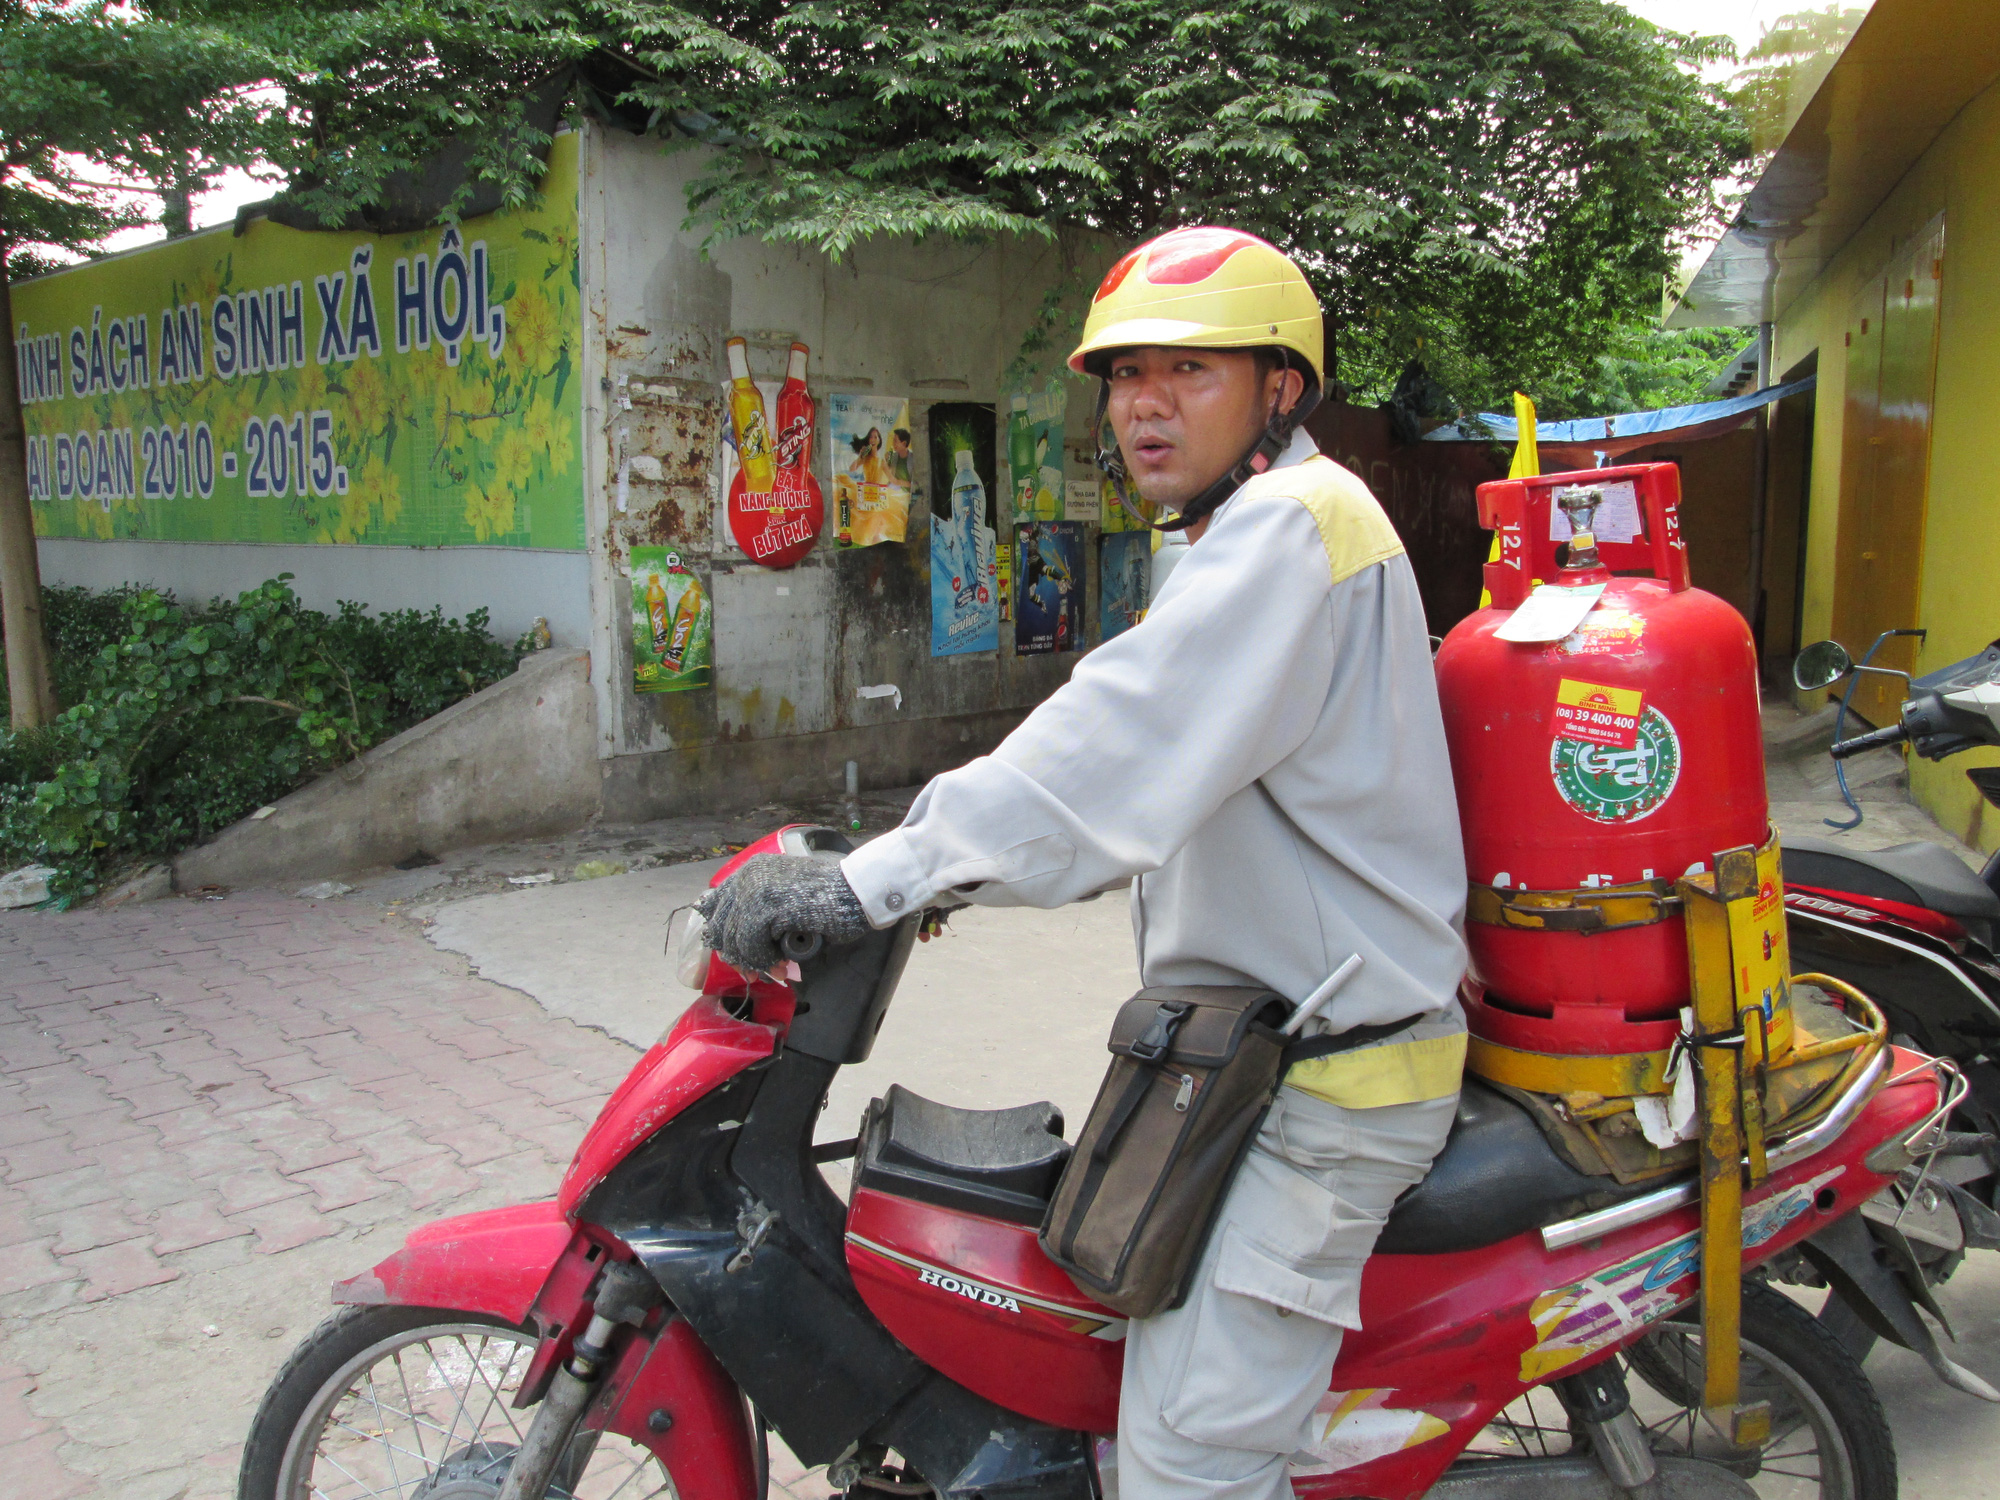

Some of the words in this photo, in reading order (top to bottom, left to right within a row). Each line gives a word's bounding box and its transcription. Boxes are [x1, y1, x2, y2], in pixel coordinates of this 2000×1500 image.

[16, 321, 63, 405] ÍNH
[70, 305, 150, 398] SÁCH
[158, 303, 204, 386] AN
[212, 282, 304, 380] SINH
[316, 243, 381, 365] XÃ
[395, 225, 506, 368] HỘI,
[56, 427, 136, 513] ĐOẠN
[142, 420, 215, 500] 2010
[245, 410, 349, 499] 2015.
[781, 424, 812, 457] STING
[781, 513, 813, 547] PHÁ
[972, 497, 990, 588] Revive
[1503, 521, 1521, 571] 12.7
[1664, 503, 1682, 551] 12.7
[948, 611, 980, 638] Revive
[1556, 707, 1574, 720] (08)
[1575, 709, 1590, 721] 39
[1591, 712, 1612, 725] 400
[1614, 716, 1635, 729] 400
[1579, 700, 1597, 709] BÌNH
[1598, 703, 1617, 712] MINH
[918, 1268, 1022, 1314] HONDA
